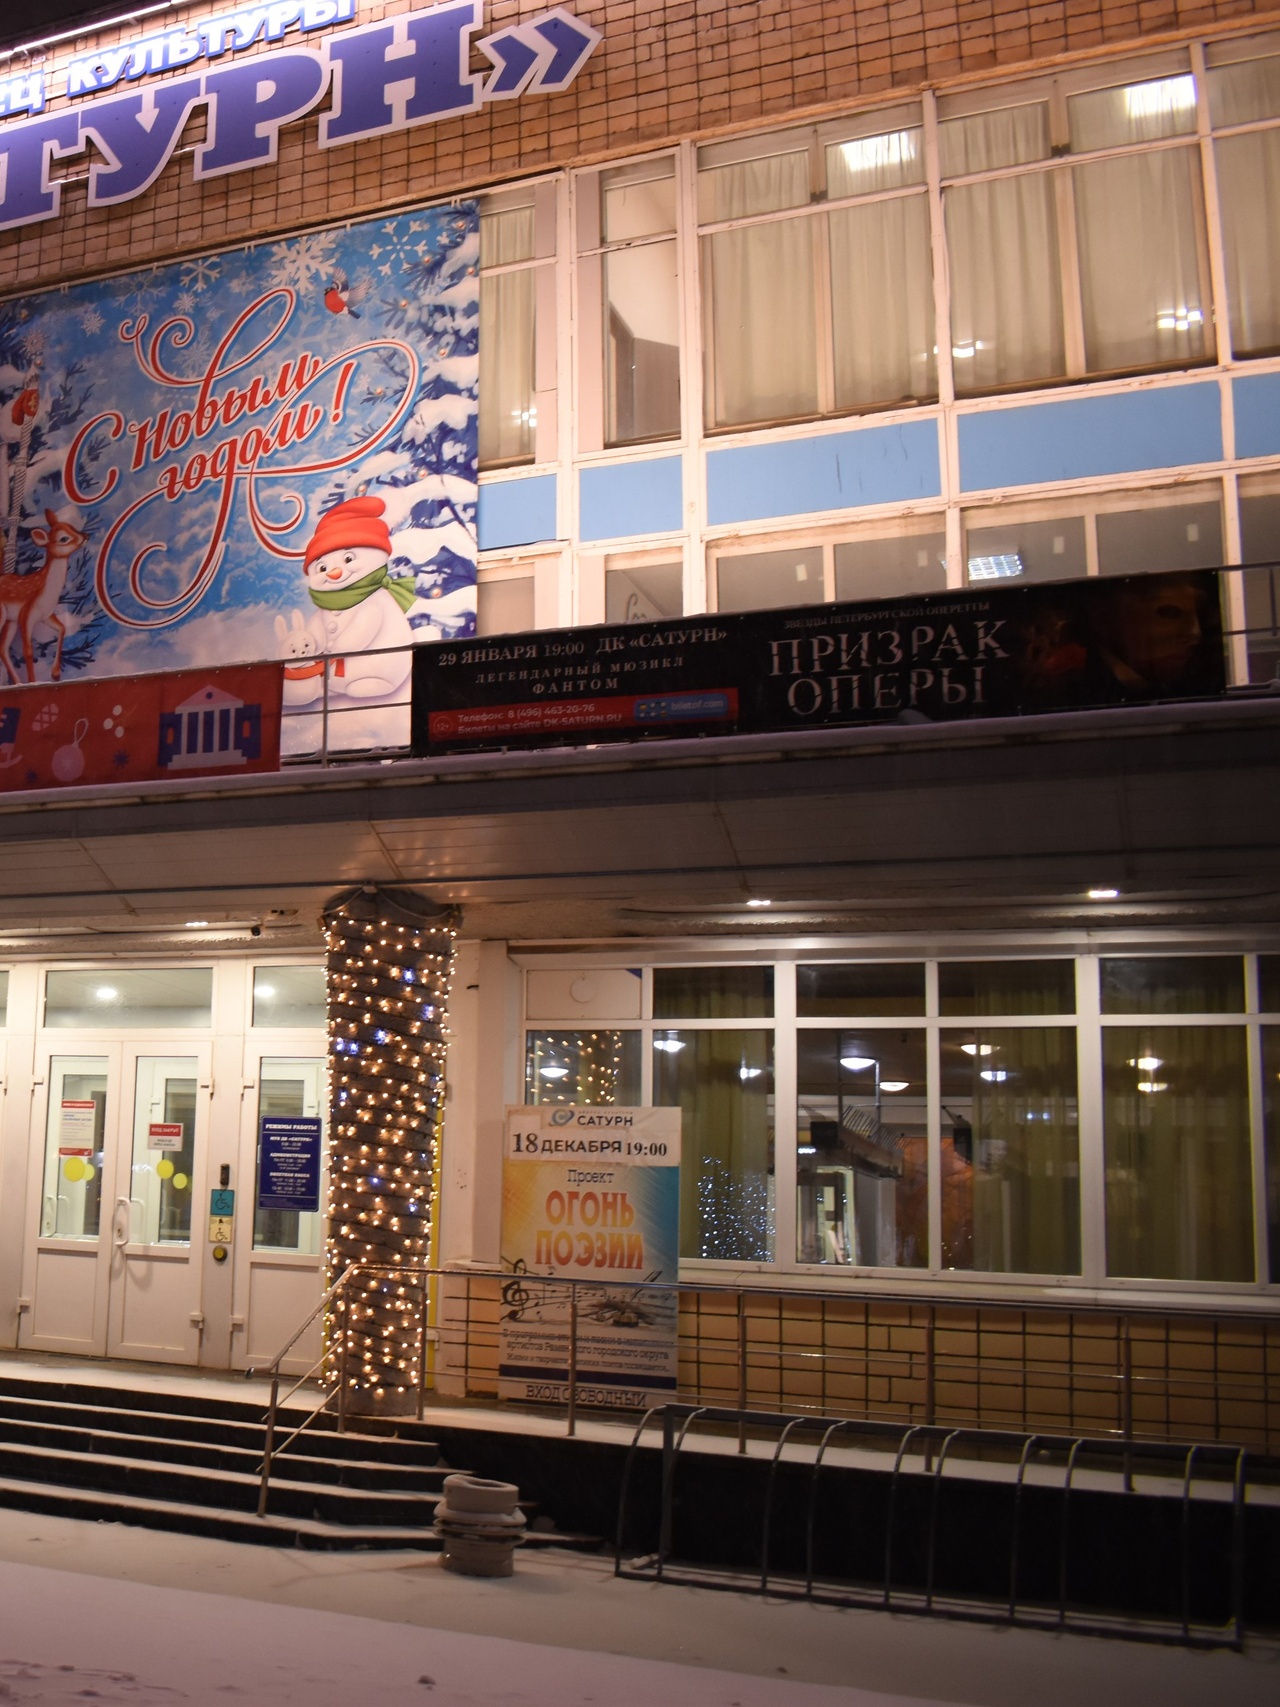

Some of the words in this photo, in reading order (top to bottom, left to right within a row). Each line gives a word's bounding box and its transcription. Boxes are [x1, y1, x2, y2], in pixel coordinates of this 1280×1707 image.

[66, 0, 354, 98] КУЛЬТУРЫ
[64, 412, 122, 502] С
[125, 315, 322, 470] Новым
[438, 653, 457, 667] 29
[461, 644, 539, 665] ЯНВАРЯ
[543, 641, 585, 657] 19:00
[595, 638, 625, 655] ДК
[629, 627, 728, 649] «САТУРН»
[768, 619, 1010, 676] ПРИЗРАК
[475, 661, 602, 684] ЛЕГЕНДАРНЫЙ
[610, 656, 684, 674] МЮЗИКЛ
[532, 677, 619, 695] ФАНТОМ
[787, 665, 987, 716] ОПЕРЫ
[507, 709, 515, 719] 8
[517, 706, 542, 719] (496)
[544, 703, 596, 716] 463-20-76
[577, 1115, 633, 1126] САТУРН
[513, 1132, 538, 1153] 18
[541, 1139, 622, 1154] ДЕКАБРЯ
[626, 1142, 667, 1156] 19:00
[567, 1169, 614, 1186] Проект
[545, 1190, 635, 1228] ОГОНЬ
[535, 1230, 644, 1269] ПОЭЗИИ
[525, 1384, 560, 1401] ВХОД
